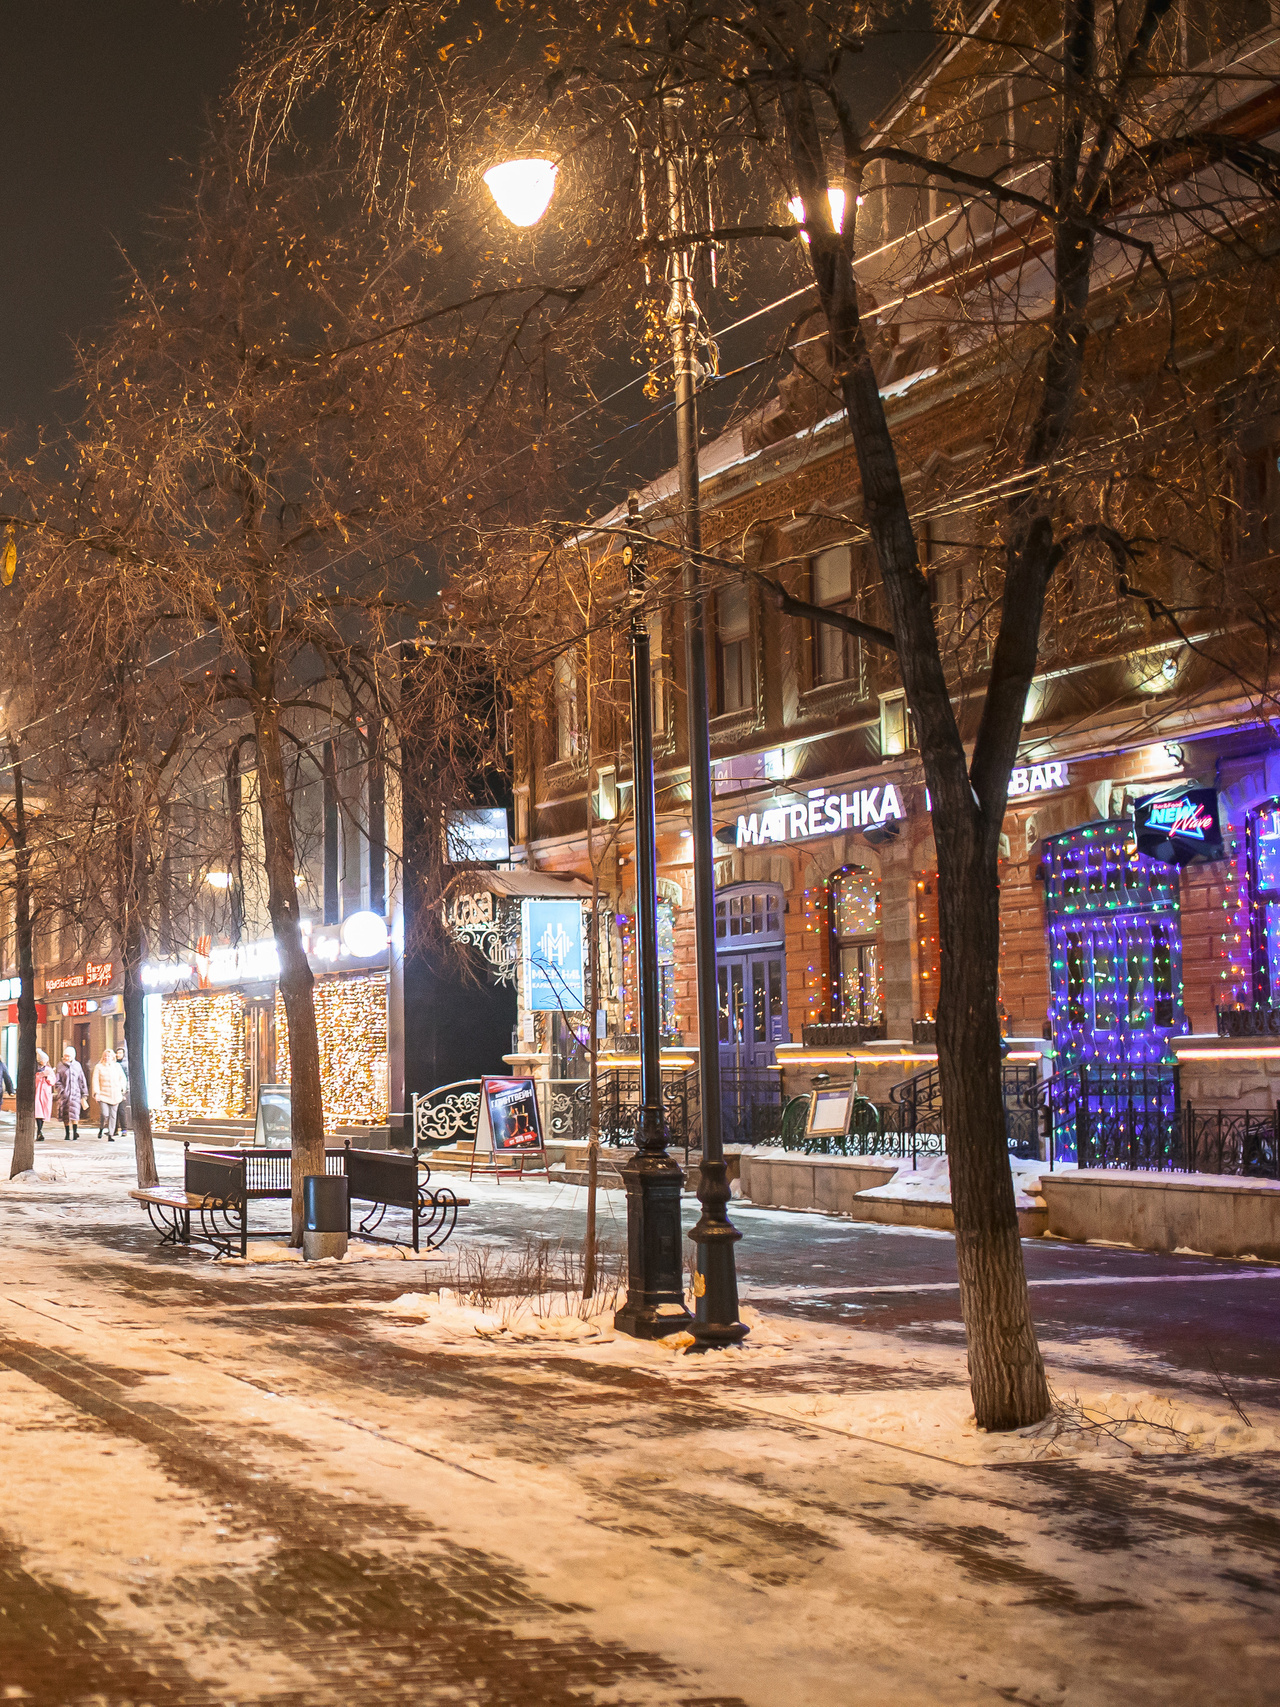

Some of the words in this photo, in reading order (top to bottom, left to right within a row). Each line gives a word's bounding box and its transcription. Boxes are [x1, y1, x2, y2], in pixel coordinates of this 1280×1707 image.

[1008, 762, 1064, 796] BAR
[1150, 805, 1197, 824] NEW
[1169, 803, 1213, 837] Wave
